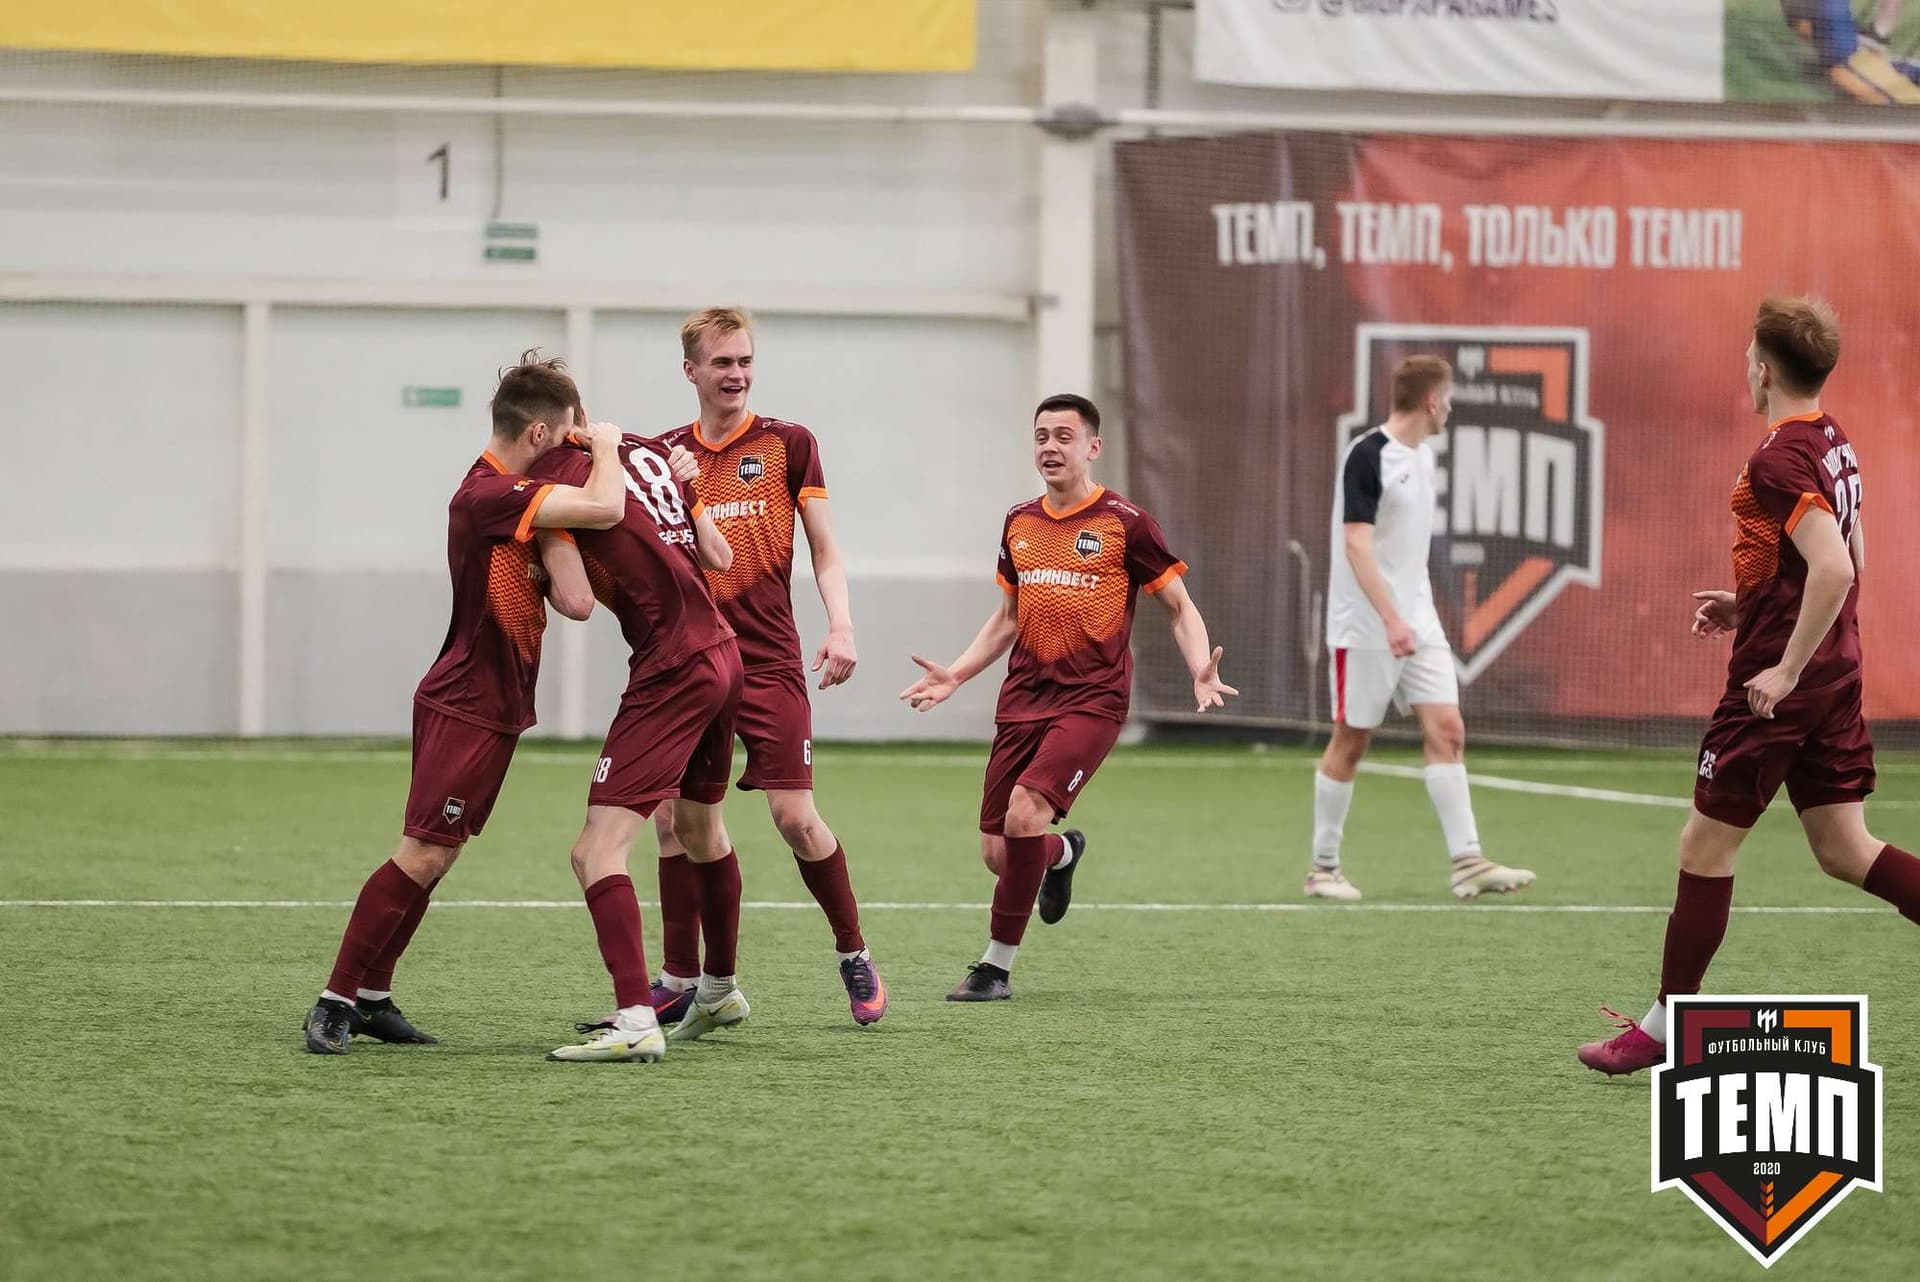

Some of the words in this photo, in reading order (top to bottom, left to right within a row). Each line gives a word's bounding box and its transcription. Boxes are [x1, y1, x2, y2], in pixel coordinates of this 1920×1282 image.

[426, 142, 449, 200] 1
[1211, 201, 1326, 270] ТЕМП,
[1337, 201, 1454, 272] ТЕМП,
[1463, 204, 1617, 269] ТОЛЬКО
[1629, 206, 1743, 269] ТЕМП!
[740, 463, 762, 476] ТЕМП
[621, 446, 686, 525] 18
[1431, 424, 1577, 548] ЕМП
[1078, 539, 1100, 552] ТЕМП
[803, 739, 811, 766] 6
[593, 757, 612, 783] 18
[1067, 769, 1083, 792] 8
